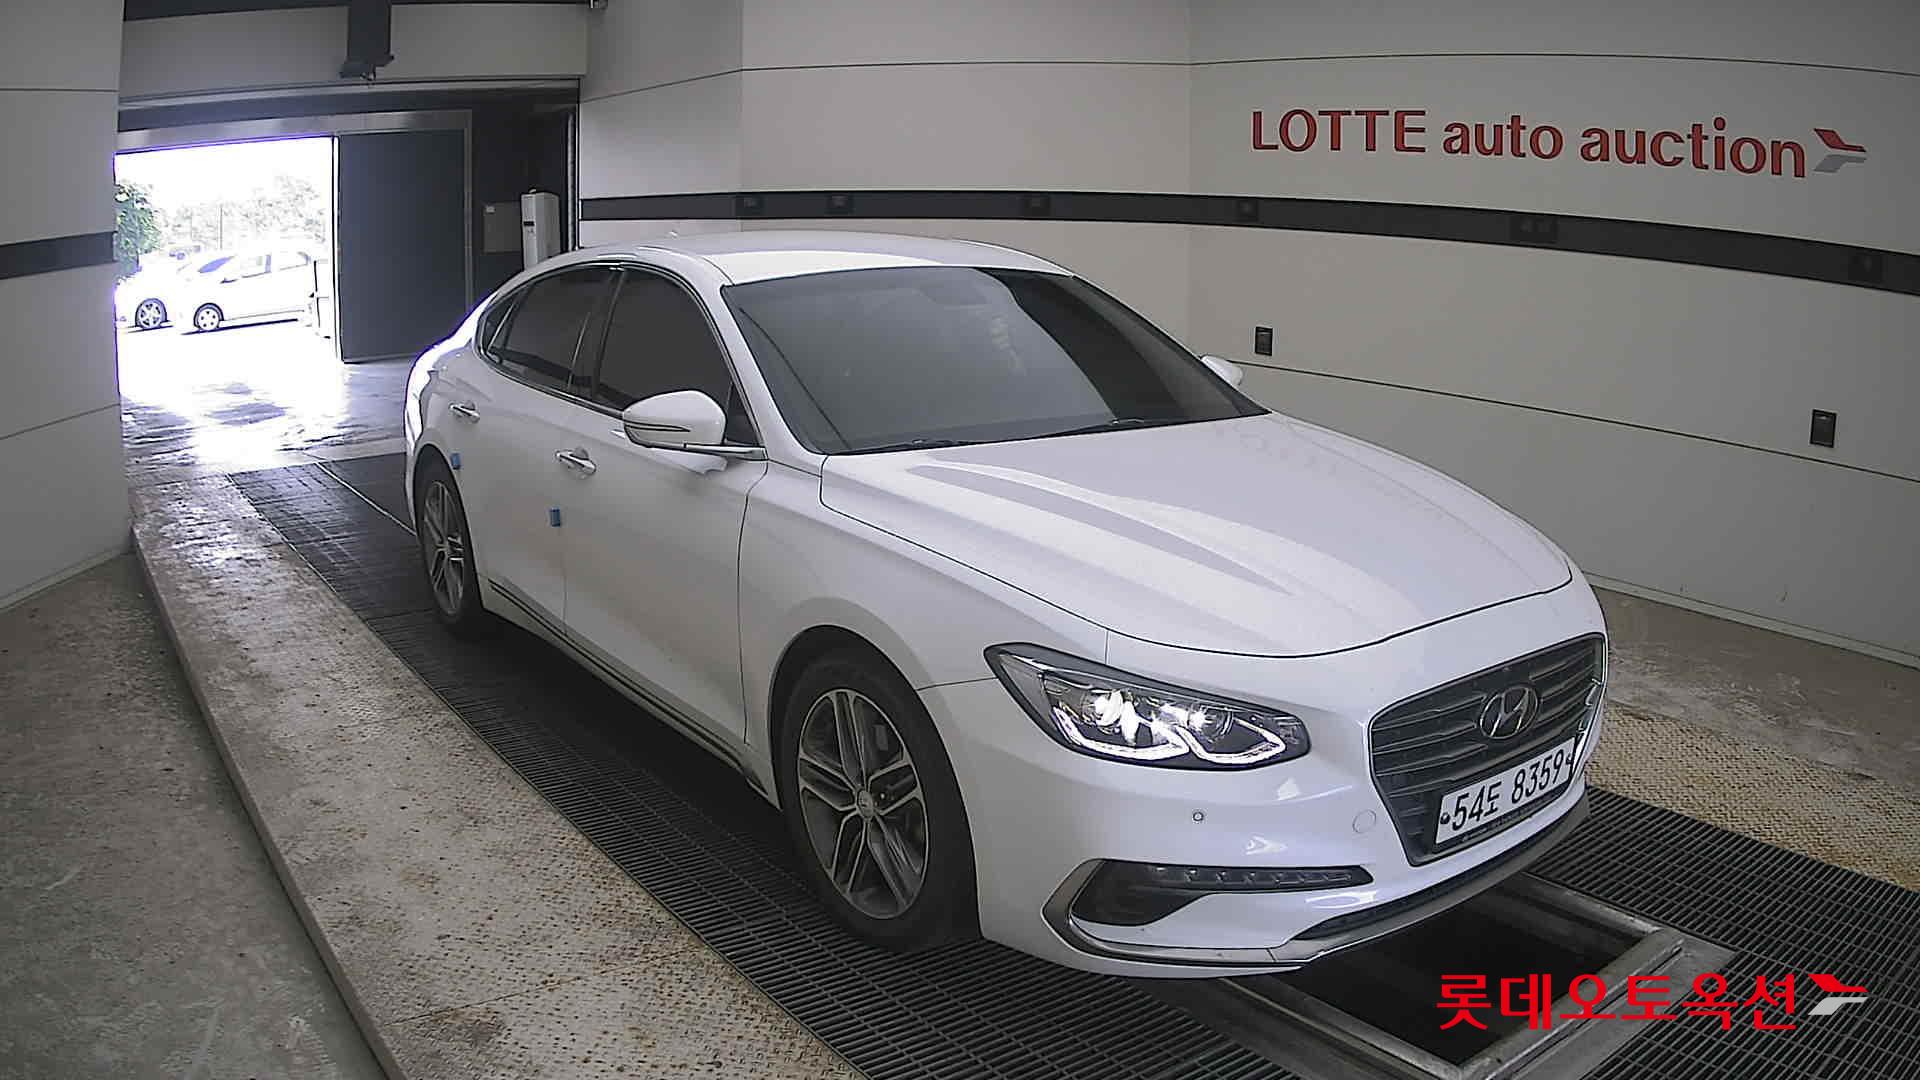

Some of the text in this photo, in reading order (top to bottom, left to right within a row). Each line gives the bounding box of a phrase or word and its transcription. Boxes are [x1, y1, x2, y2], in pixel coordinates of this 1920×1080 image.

[1251, 109, 1807, 178] LOTTE auto auction
[1452, 749, 1564, 831] 54도 8359
